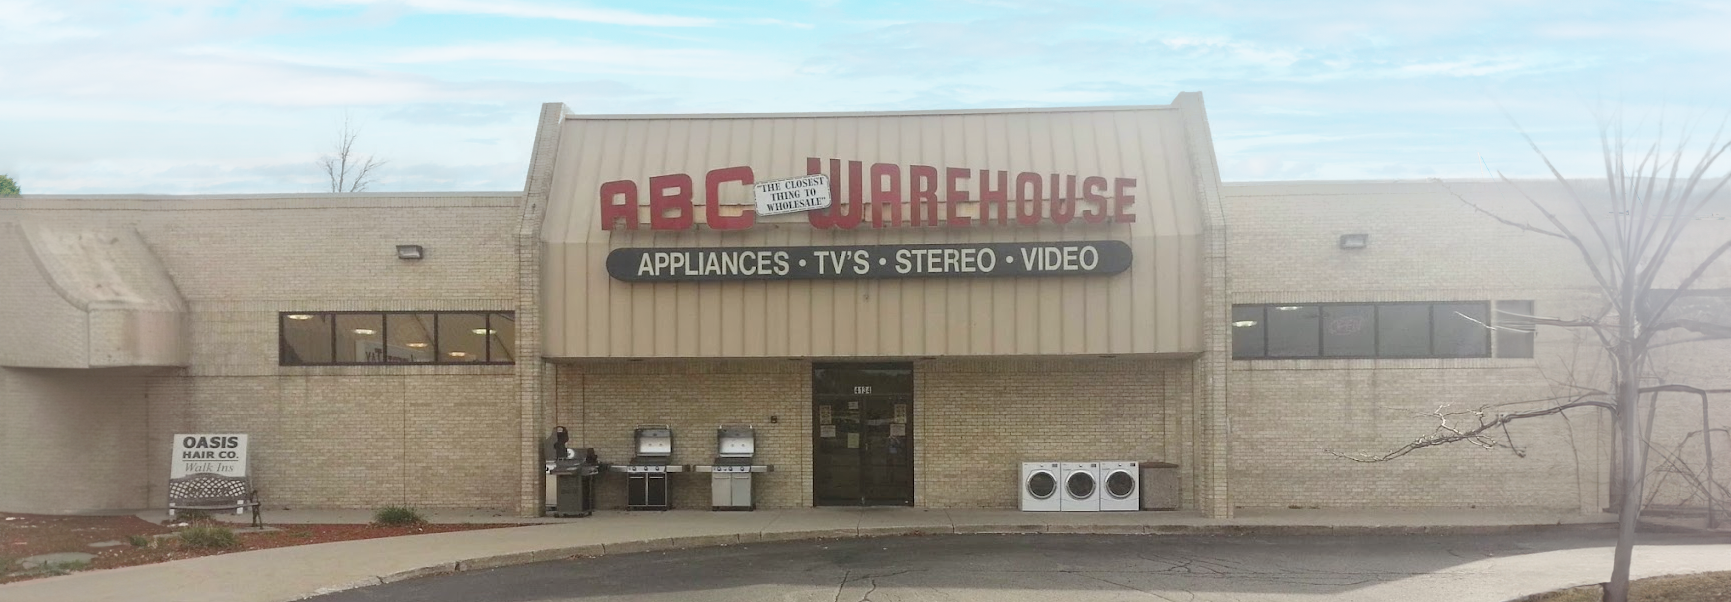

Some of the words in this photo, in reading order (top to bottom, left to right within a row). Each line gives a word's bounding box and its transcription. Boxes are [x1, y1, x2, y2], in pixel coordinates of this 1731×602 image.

[785, 177, 824, 190] CLOSEST
[600, 165, 755, 231] ABC
[807, 157, 1137, 230] WAREHOUSE
[770, 190, 800, 201] THING
[804, 188, 816, 197] TO
[637, 251, 790, 276] APPLIANCES
[813, 250, 870, 275] TV'S
[895, 247, 996, 274] STEREO
[1020, 245, 1099, 272] VIDEO
[183, 436, 238, 449] OASIS
[182, 451, 215, 459] HAIR
[218, 451, 239, 459] CO.
[185, 462, 213, 472] Walk
[216, 462, 234, 472] Ins
